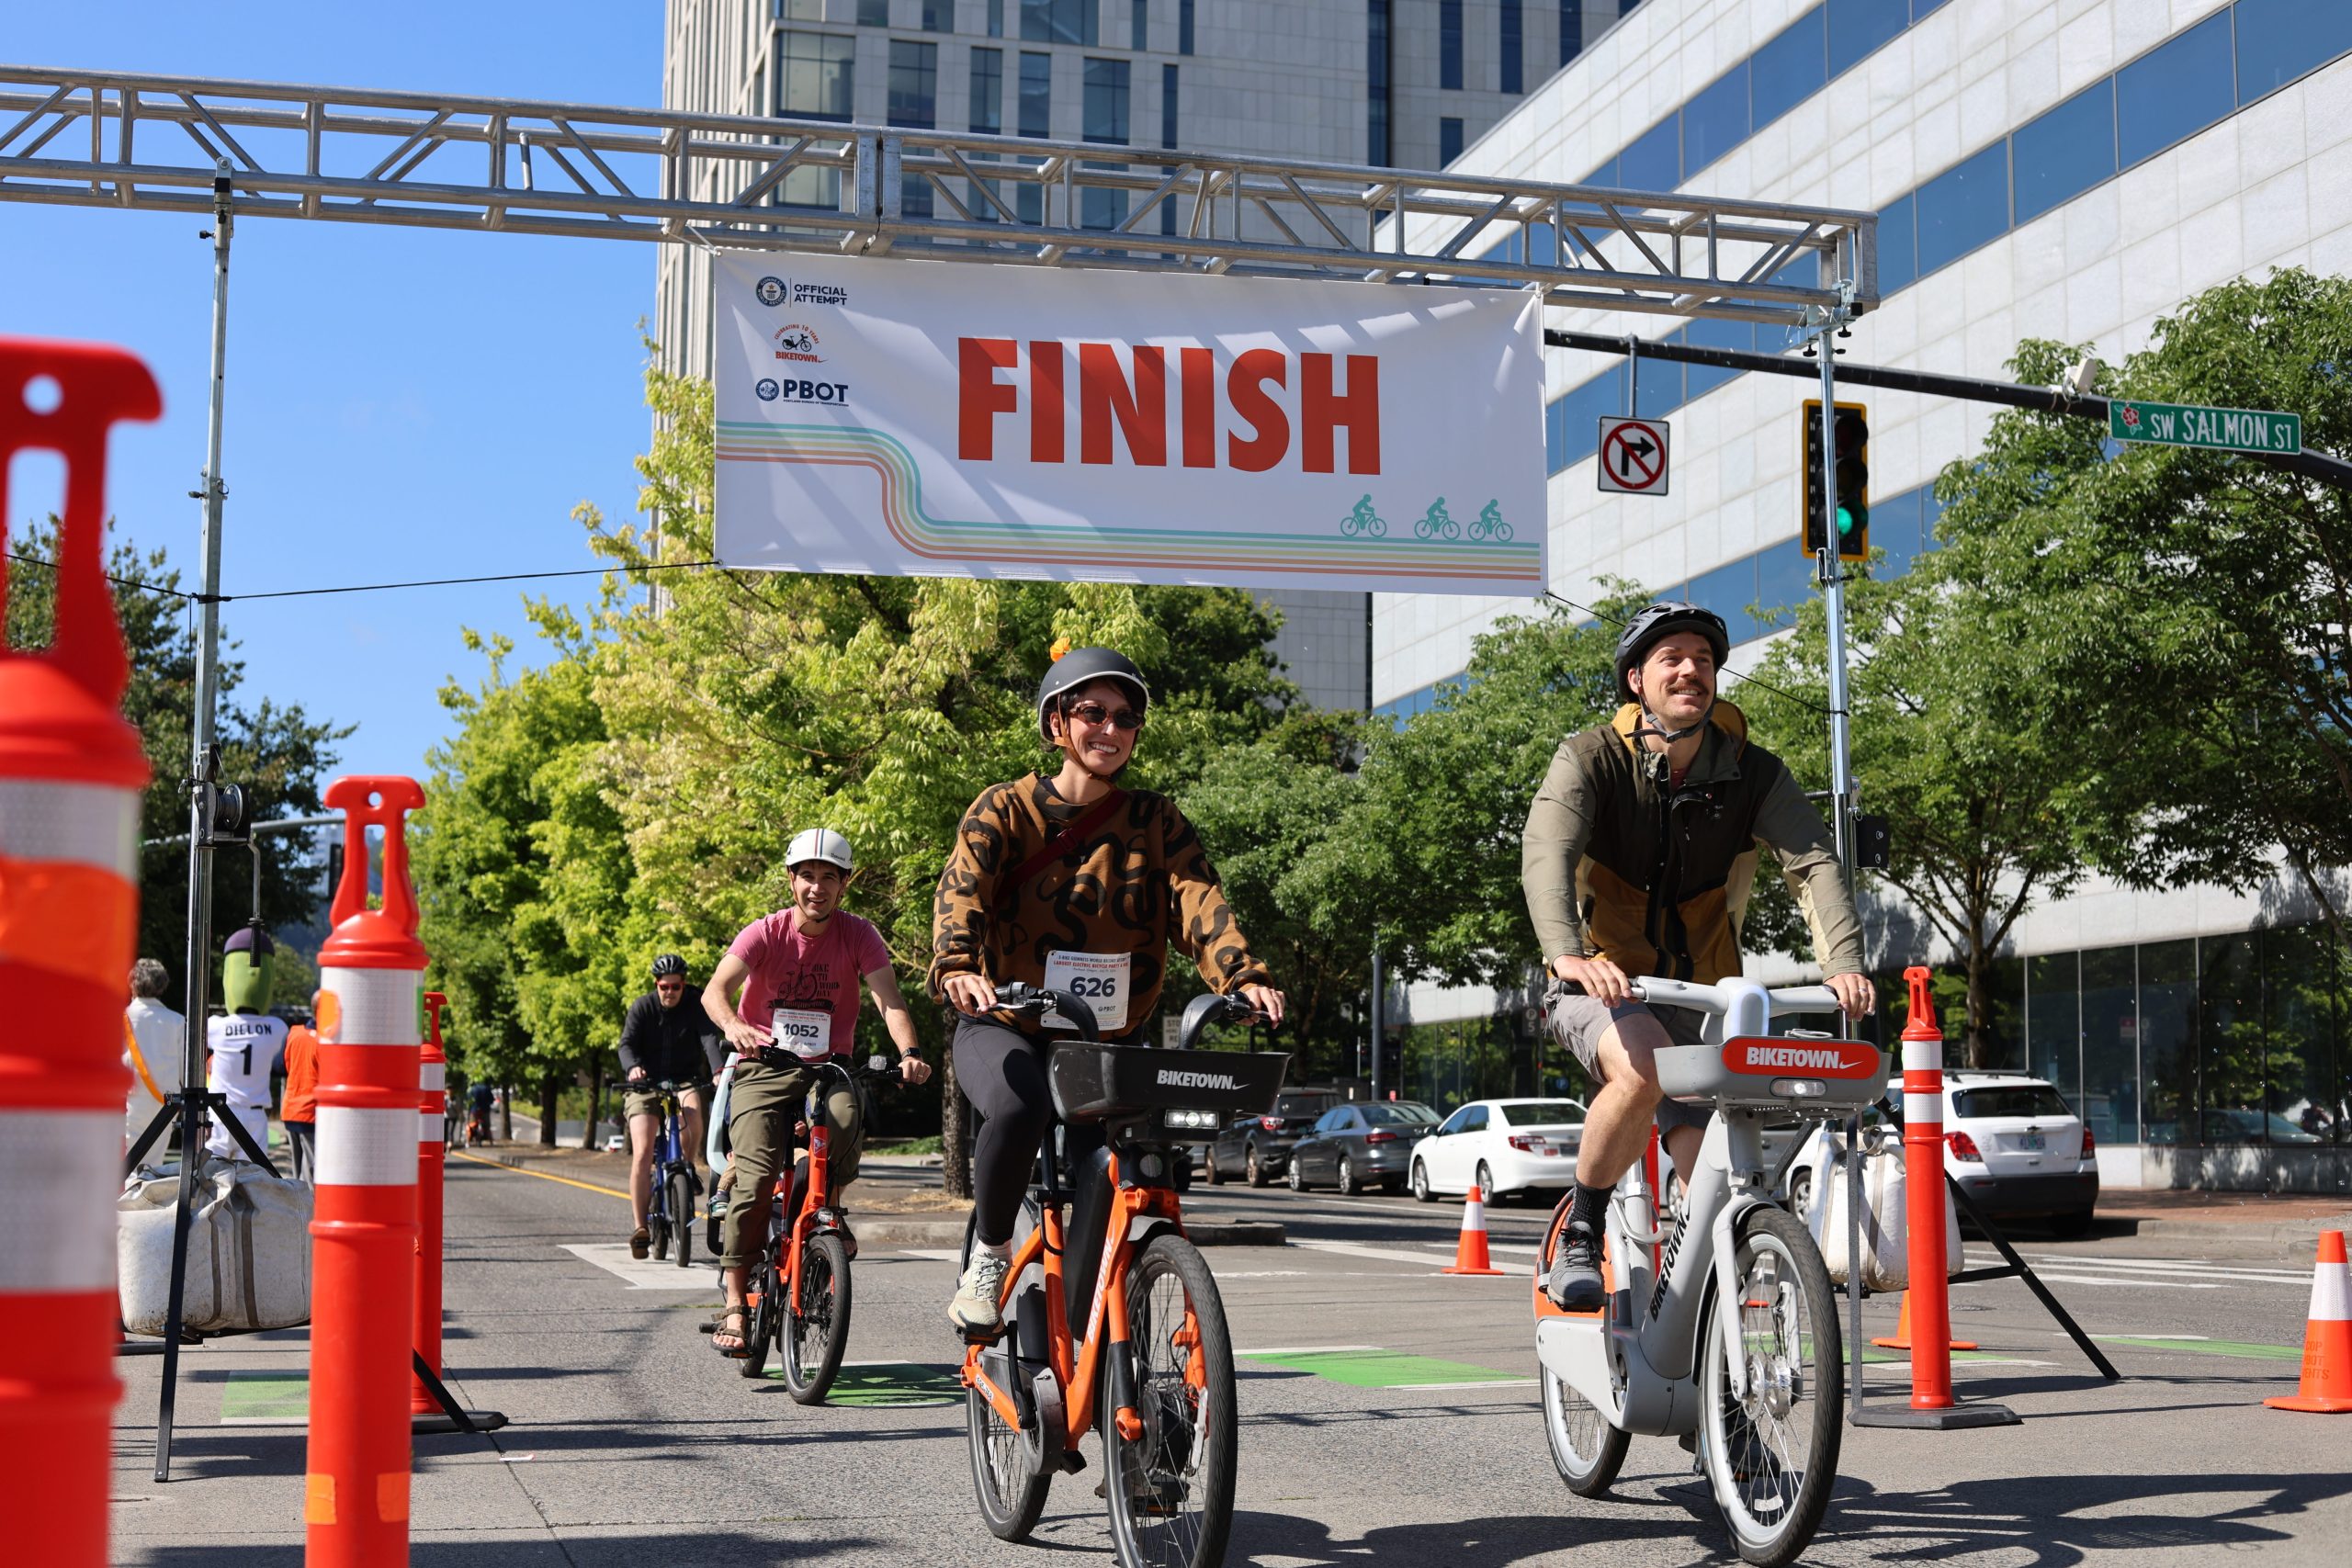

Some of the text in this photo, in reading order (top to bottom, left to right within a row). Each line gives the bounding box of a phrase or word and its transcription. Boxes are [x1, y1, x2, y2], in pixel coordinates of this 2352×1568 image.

[794, 284, 847, 296] OFFICIAL
[794, 294, 847, 306] ATTEMPT
[775, 351, 818, 363] BIKETOWN
[783, 378, 849, 402] PBOT
[958, 337, 1381, 475] FINISH
[2150, 410, 2292, 449] SW SALMON ST
[1069, 976, 1115, 998] 626
[224, 1023, 272, 1037] DILLON
[783, 1023, 820, 1038] 1052
[1529, 1021, 1535, 1032] 5
[240, 1043, 252, 1077] 1
[1747, 1047, 1839, 1069] BIKETOWN
[1157, 1069, 1233, 1089] BIKETOWN
[1650, 1215, 1687, 1323] BIKETOWN
[1087, 1236, 1112, 1345] BIKETOWN
